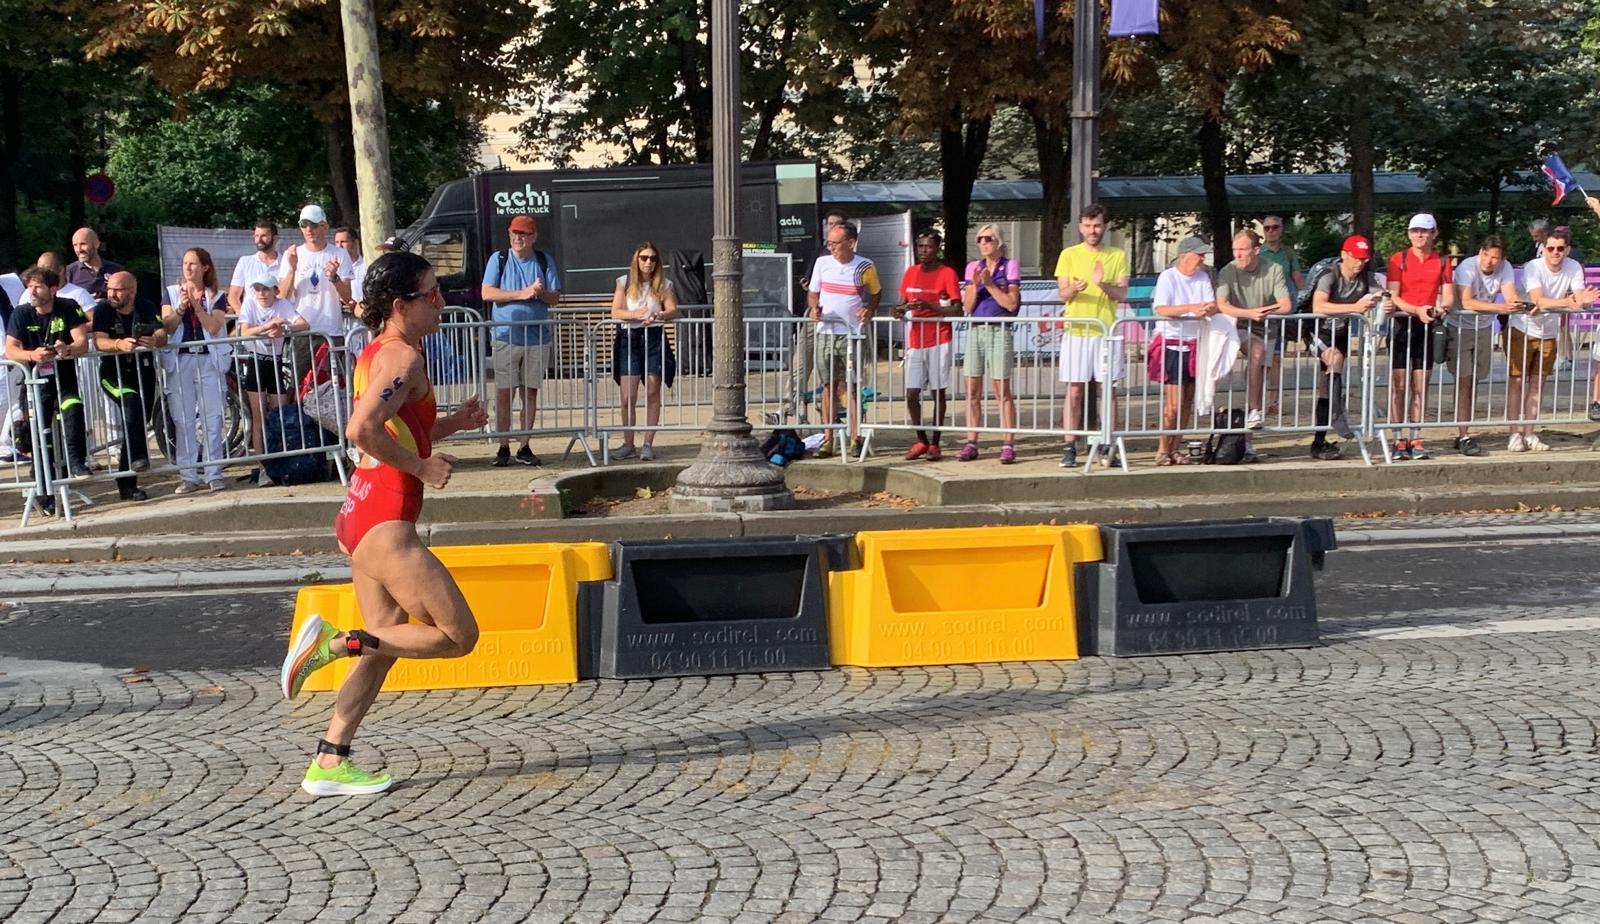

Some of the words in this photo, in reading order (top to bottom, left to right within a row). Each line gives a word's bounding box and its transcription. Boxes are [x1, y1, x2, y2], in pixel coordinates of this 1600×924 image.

[496, 207, 504, 215] le
[506, 206, 526, 215] food
[527, 205, 549, 214] truck
[627, 632, 676, 648] www
[692, 625, 758, 645] sodirel
[776, 626, 817, 642] com
[879, 622, 927, 637] www
[942, 614, 1007, 635] sodirel
[1024, 616, 1065, 632] com
[520, 638, 563, 655] com
[903, 641, 923, 659] 04
[930, 640, 953, 658] 90
[960, 639, 977, 657] 11
[986, 638, 1008, 656] 16
[1012, 637, 1034, 655] 00
[650, 652, 672, 670] 04
[679, 651, 701, 669] 90
[709, 649, 728, 668] 11
[737, 648, 758, 667] 16
[764, 647, 786, 666] 00
[416, 664, 440, 683] 90
[448, 662, 470, 682] 11
[479, 661, 500, 681] 16
[506, 659, 530, 679] 00
